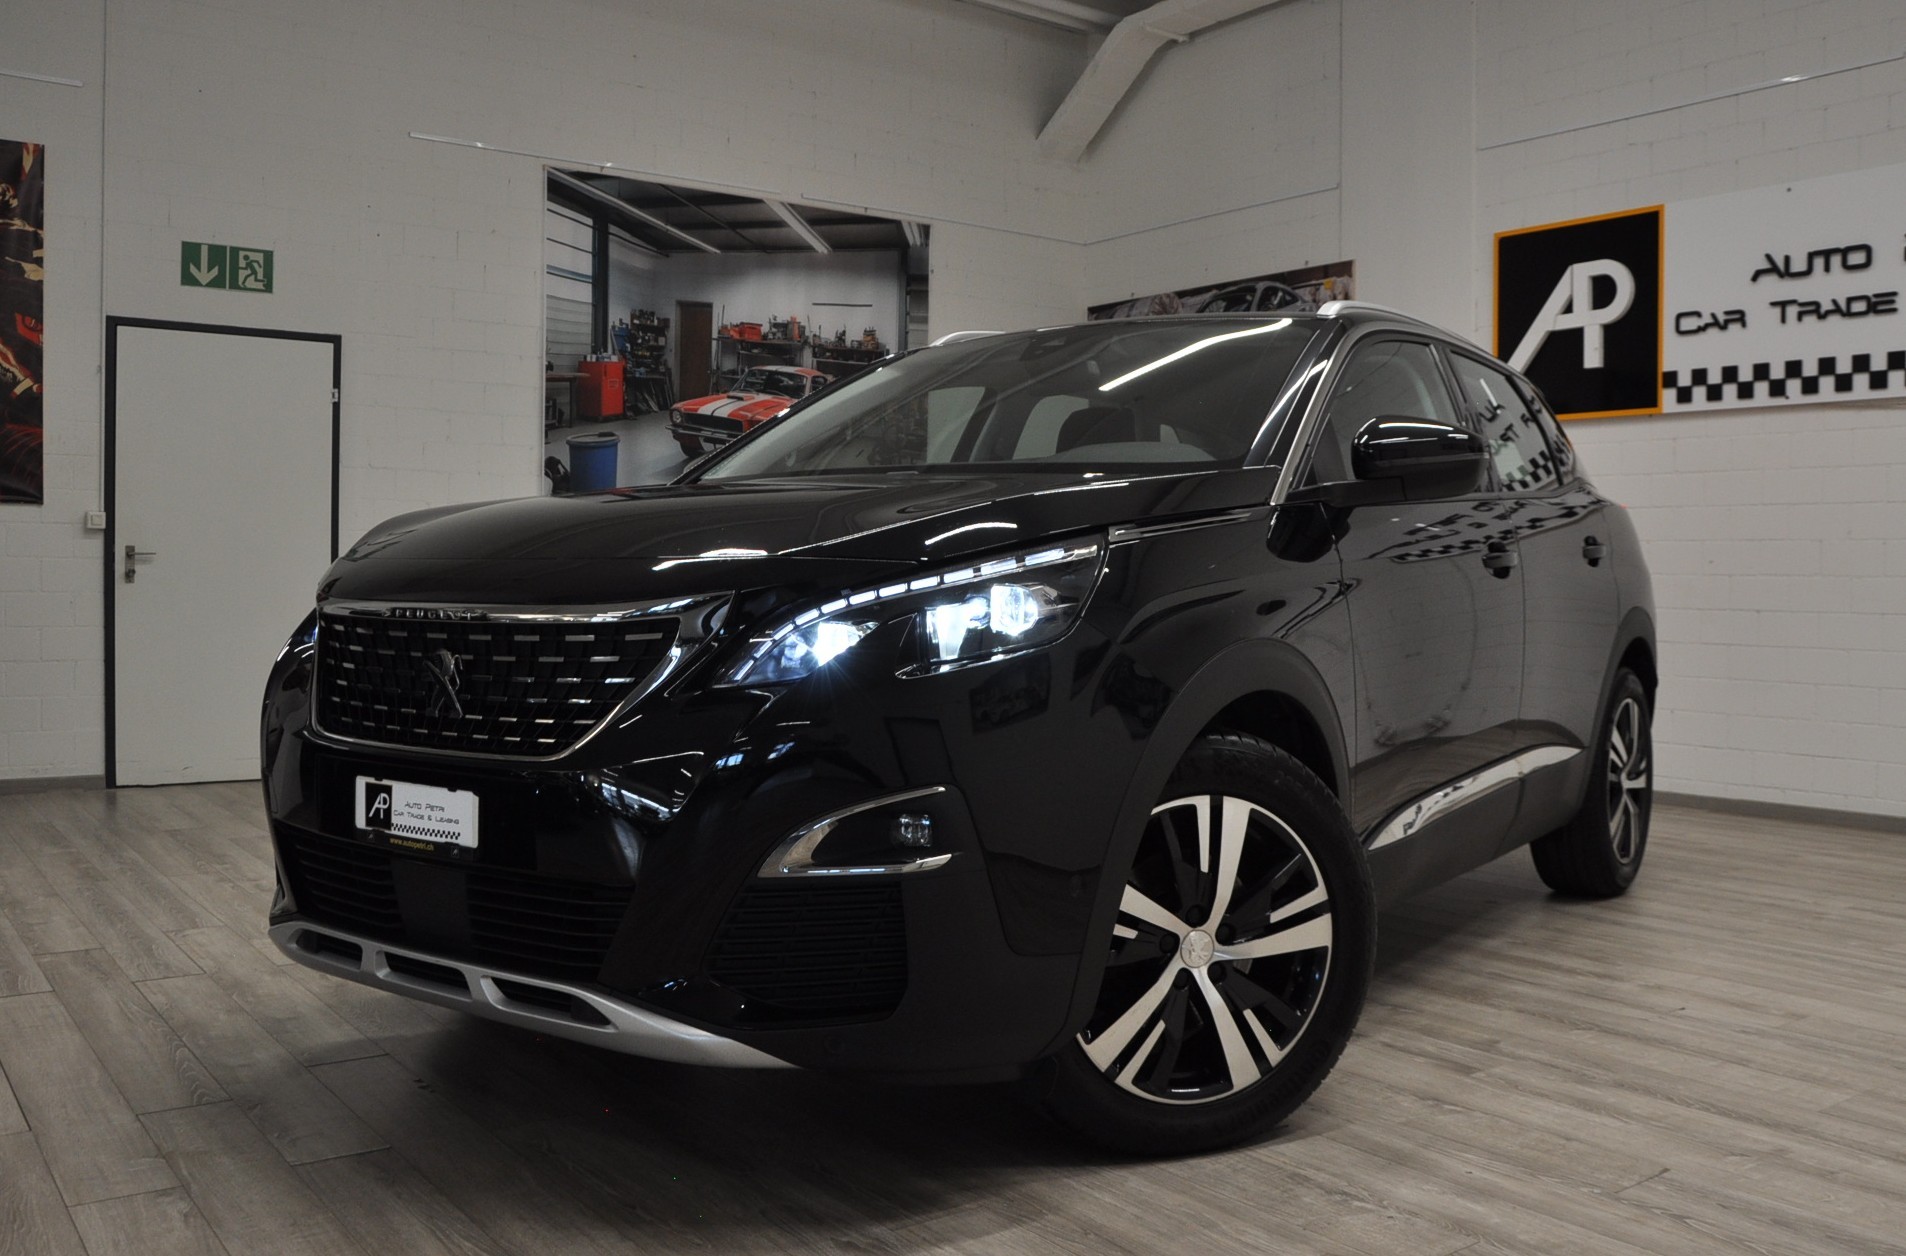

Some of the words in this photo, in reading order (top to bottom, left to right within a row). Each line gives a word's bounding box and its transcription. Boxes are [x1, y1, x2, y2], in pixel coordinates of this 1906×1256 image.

[1751, 243, 1872, 282] AUTO
[1507, 258, 1636, 369] AP
[1675, 309, 1746, 335] CAR
[1769, 291, 1899, 323] TRADE
[368, 792, 390, 819] AP
